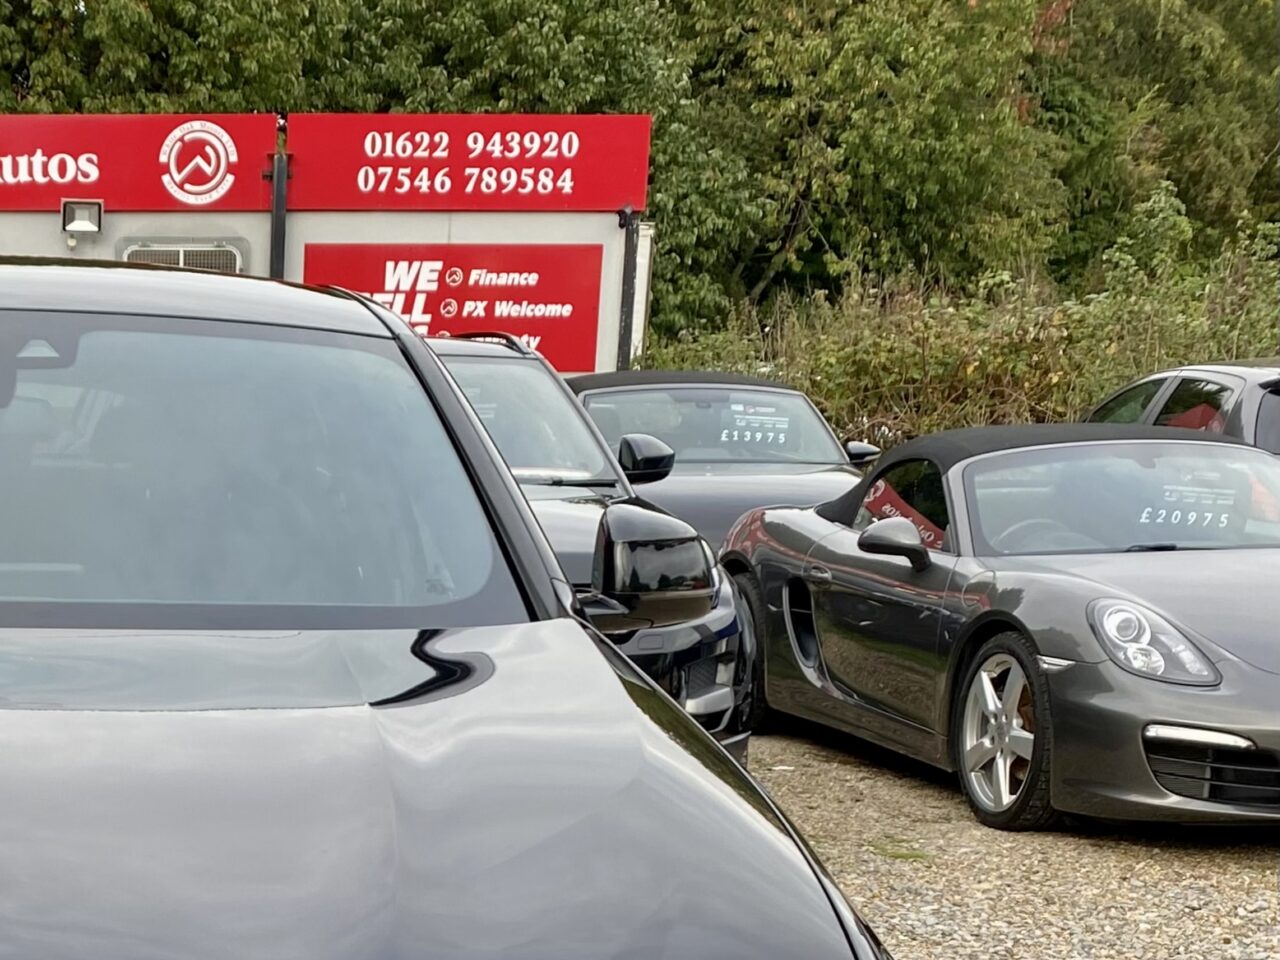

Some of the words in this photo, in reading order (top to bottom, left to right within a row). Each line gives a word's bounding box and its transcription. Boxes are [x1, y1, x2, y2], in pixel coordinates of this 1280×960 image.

[364, 131, 450, 158] 01622
[466, 131, 580, 159] 943920
[357, 166, 452, 193] 07546
[464, 167, 574, 194] 789584
[384, 260, 443, 292] WE
[468, 269, 539, 287] Finance
[461, 300, 488, 318] PX
[494, 300, 573, 318] Welcome
[720, 429, 786, 444] £13975
[1139, 507, 1230, 528] £20975
